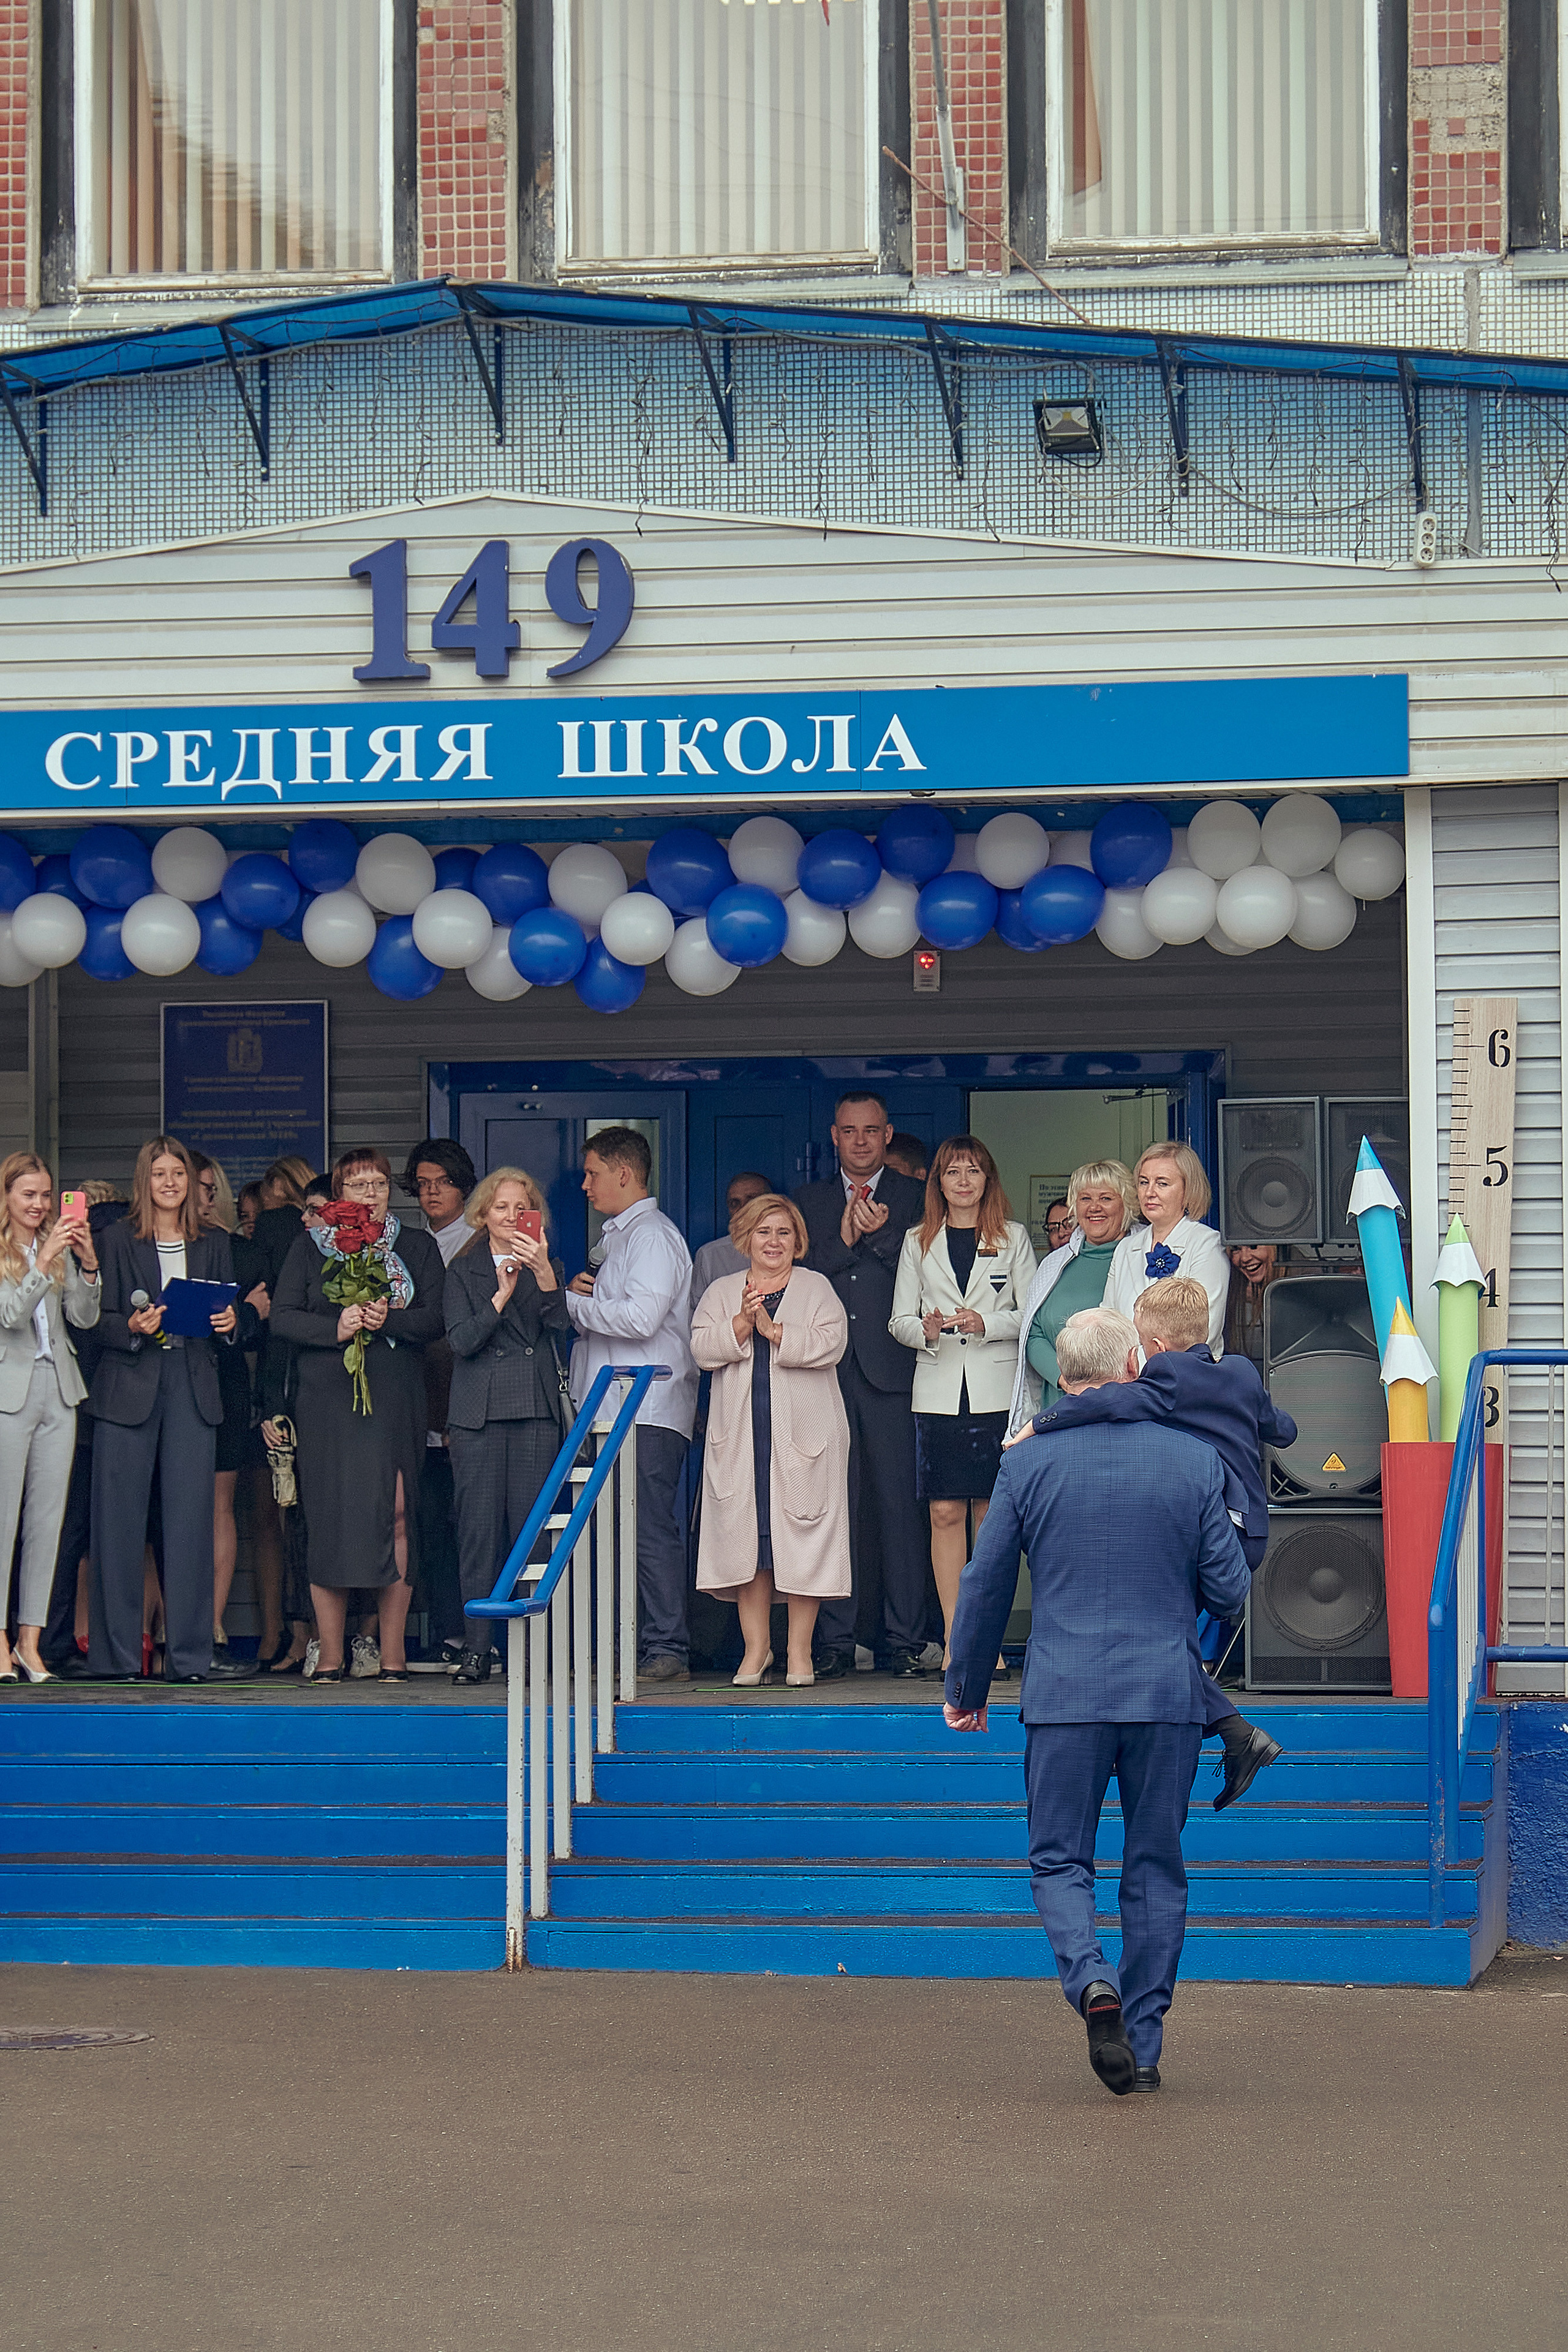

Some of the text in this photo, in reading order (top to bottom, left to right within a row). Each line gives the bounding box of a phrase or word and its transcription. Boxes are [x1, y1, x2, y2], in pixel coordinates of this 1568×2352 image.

[349, 537, 635, 682] 149
[44, 713, 928, 802] СРЕДНЯЯ ШКОЛА
[1488, 1028, 1511, 1068] 6
[1482, 1145, 1509, 1187] 5
[1483, 1267, 1501, 1308] 4
[1483, 1385, 1500, 1428] 3
